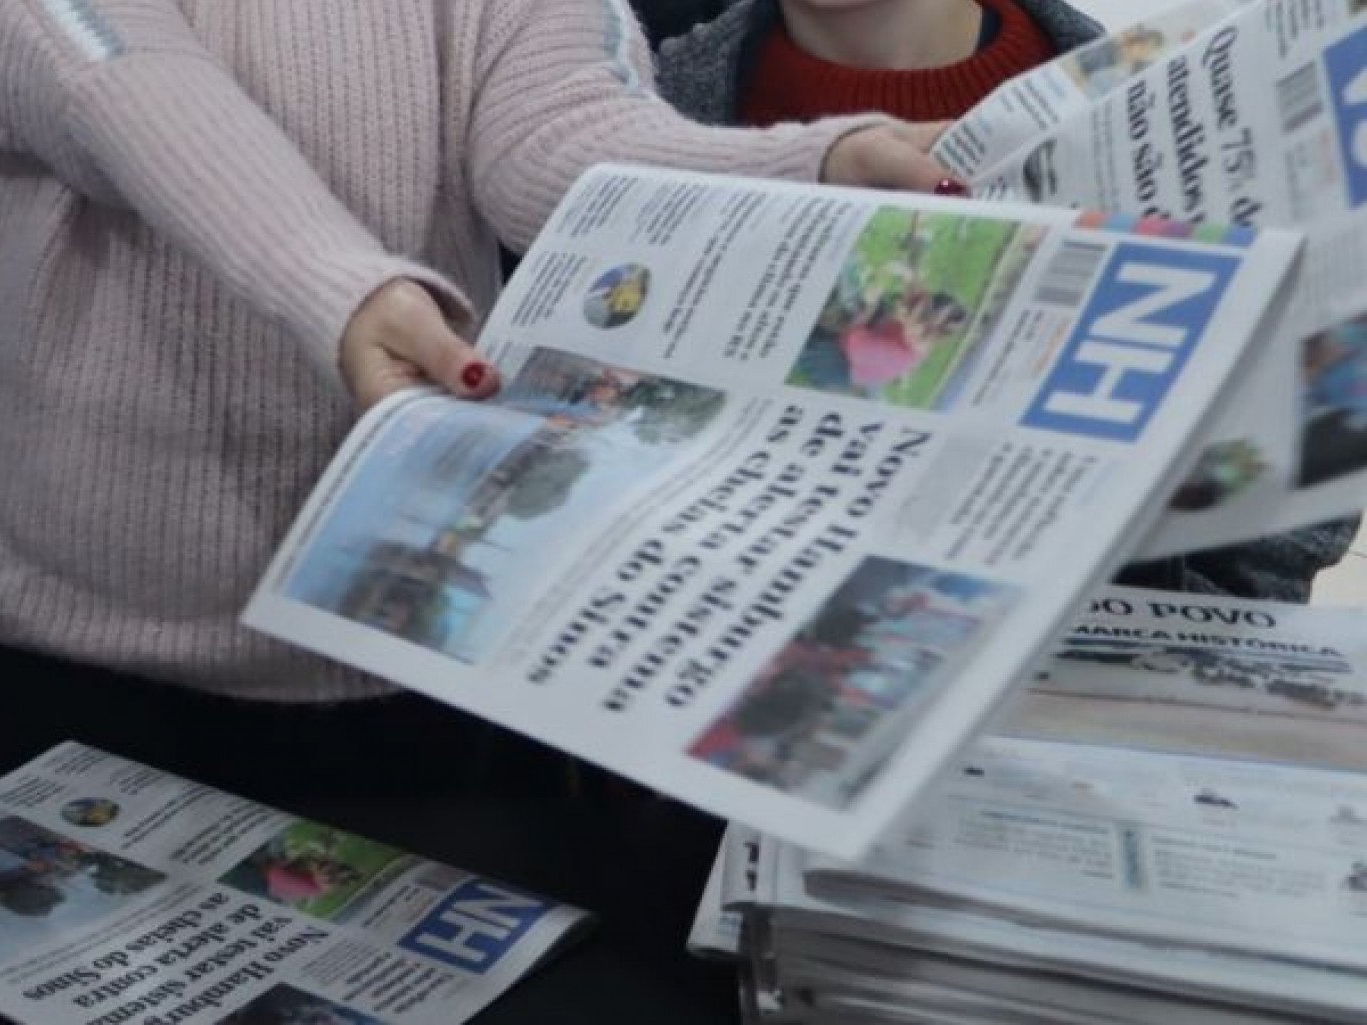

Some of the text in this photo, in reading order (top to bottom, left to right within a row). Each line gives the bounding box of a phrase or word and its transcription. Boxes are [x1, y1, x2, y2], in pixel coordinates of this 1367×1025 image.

[1128, 80, 1155, 142] não
[1202, 26, 1237, 131] Quase
[1134, 143, 1164, 204] são
[1167, 55, 1207, 213] atendidos
[1043, 262, 1219, 426] NH
[847, 425, 932, 518] Novo
[529, 404, 804, 684] as cheias do Sinos
[588, 411, 845, 668] de alerta contra
[602, 421, 886, 712] vai testar sistema
[665, 522, 858, 707] Hamburgo
[1147, 602, 1277, 628] POVO
[23, 892, 230, 1000] as cheias do Sinos
[72, 903, 262, 1008] de alerta contra
[185, 939, 259, 981] testar
[250, 917, 293, 942] vai
[263, 926, 330, 962] Novo
[416, 884, 545, 963] NH
